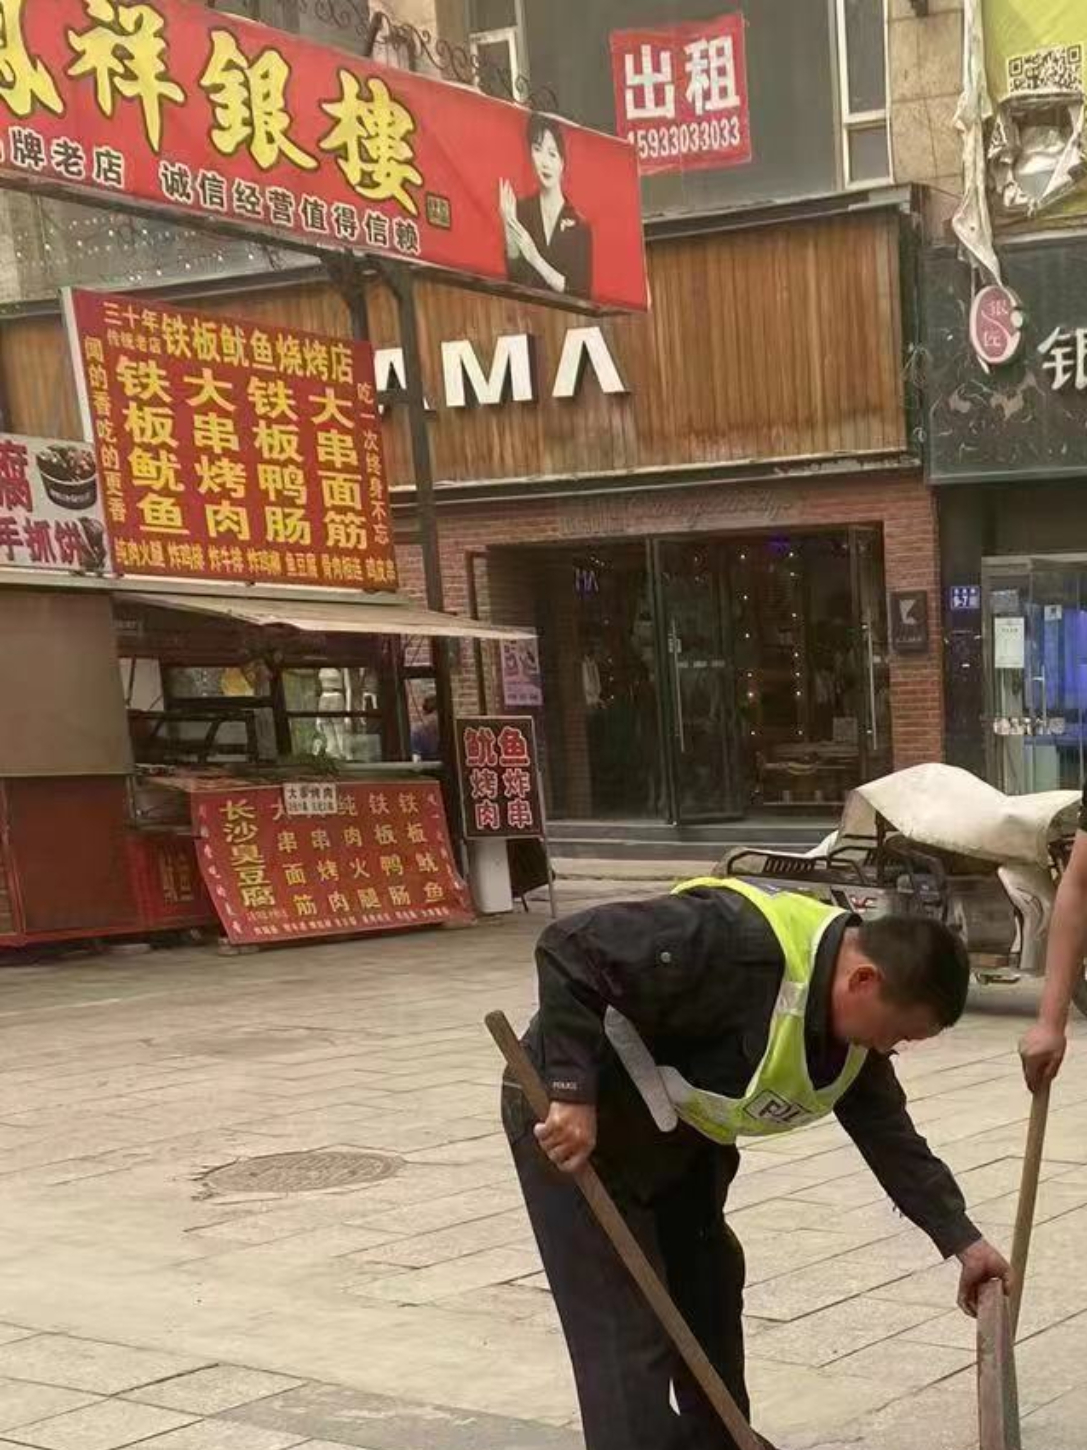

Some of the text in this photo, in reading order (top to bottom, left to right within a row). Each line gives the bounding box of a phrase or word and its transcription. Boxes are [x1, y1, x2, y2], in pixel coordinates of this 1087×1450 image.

[624, 35, 740, 120] 出租
[0, 126, 125, 187] 牌老店
[159, 160, 421, 253] 诚信经营值得信赖
[627, 116, 741, 158] 15933033033
[103, 301, 159, 333] 三十年
[161, 312, 353, 385] 铁板鱿鱼烧烤店
[115, 354, 190, 534] 铁板鱿鱼
[183, 366, 251, 541] 大串烤肉
[247, 376, 312, 546] 铁板鸭肠
[308, 387, 368, 550] 大串面筋
[463, 727, 530, 766] 鱿鱼
[219, 798, 276, 907] 长沙臭豆腐
[308, 813, 350, 913] 串烤肉
[368, 792, 412, 906] 铁板鸭肠
[399, 791, 446, 903] 铁板鱿鱼
